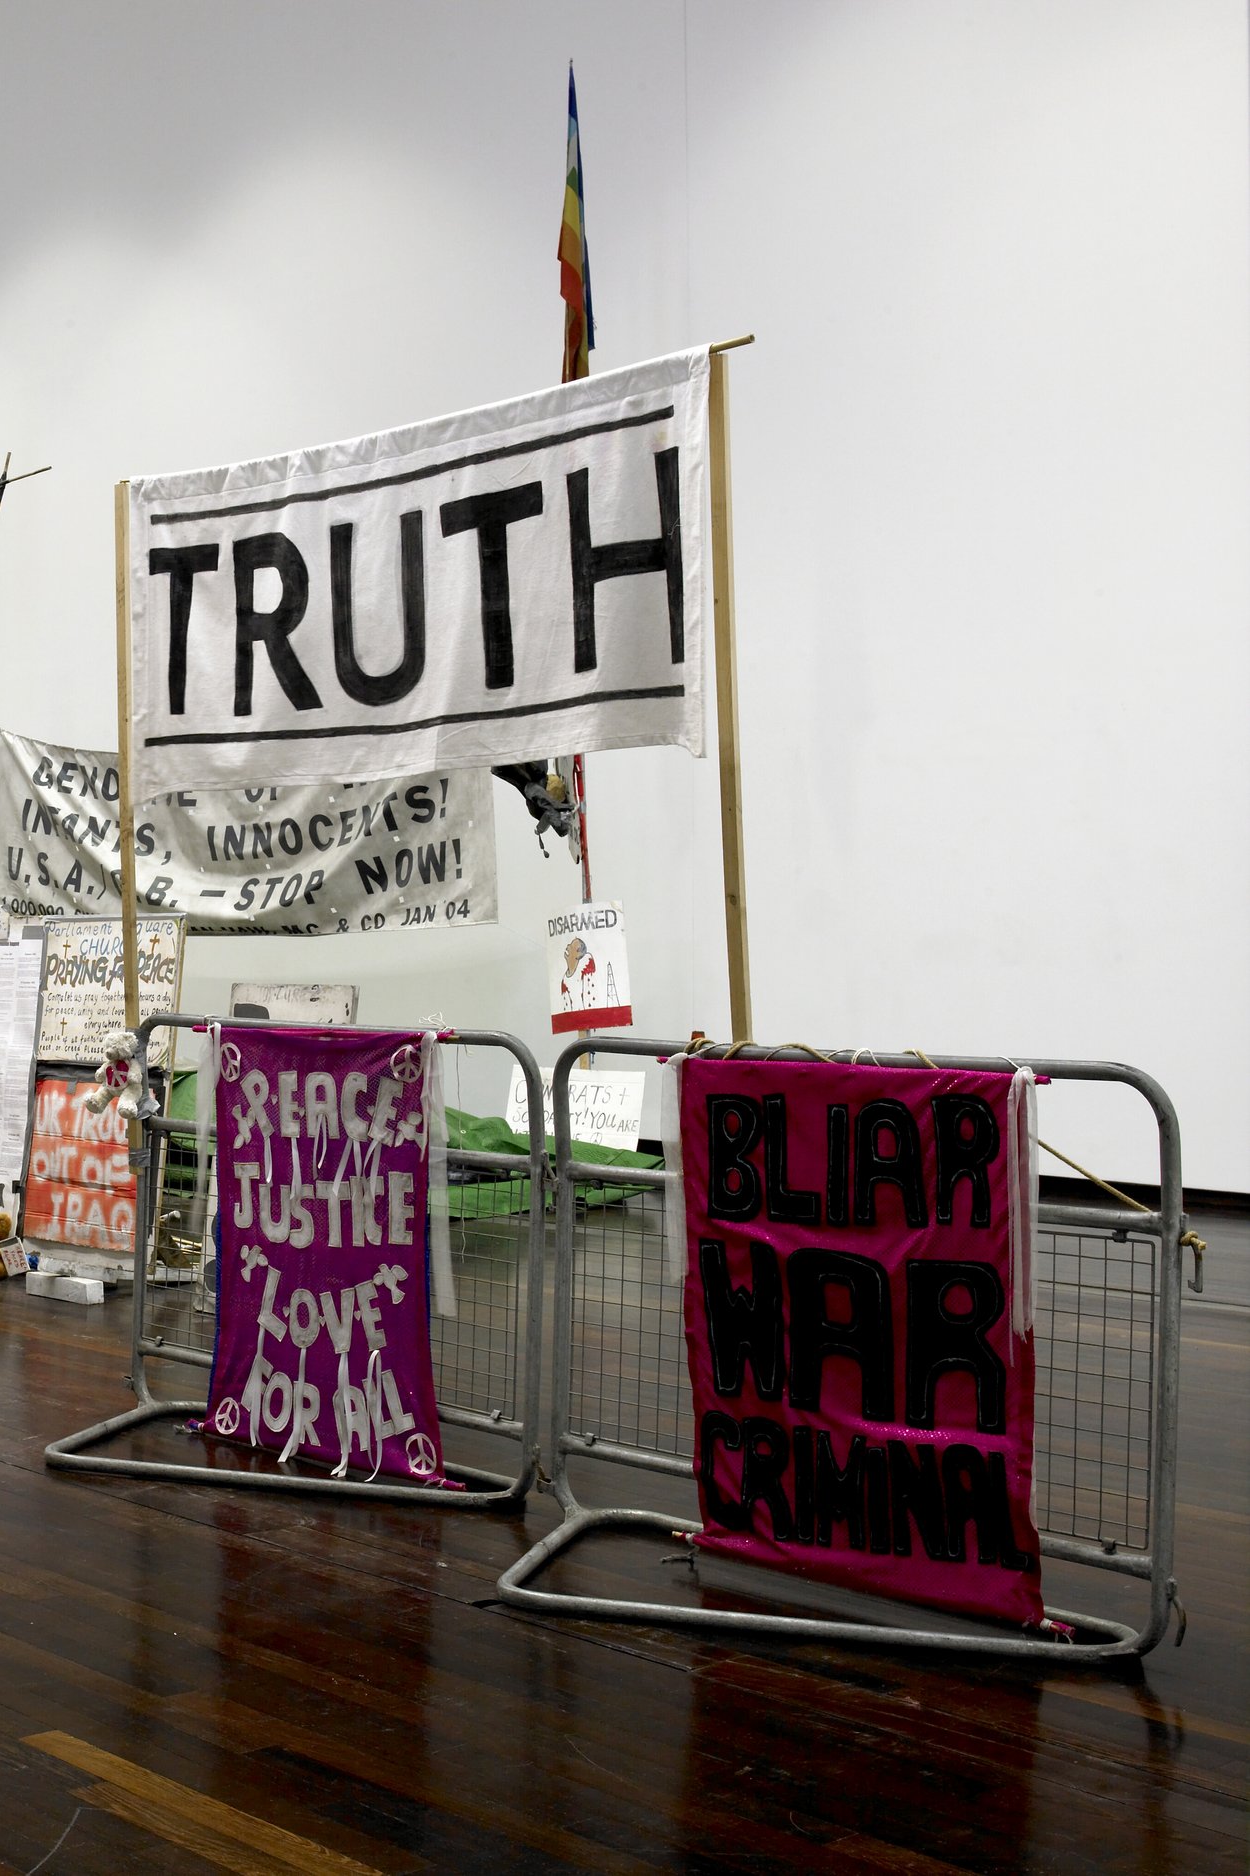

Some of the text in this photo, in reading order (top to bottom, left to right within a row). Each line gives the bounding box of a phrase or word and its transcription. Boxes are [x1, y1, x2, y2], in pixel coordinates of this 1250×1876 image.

[149, 446, 685, 717] TRUTH
[207, 778, 449, 861] INNOCENTS!
[233, 838, 462, 911] STOP NOW!
[400, 904, 437, 927] JAN
[547, 909, 618, 938] DISARMED
[45, 953, 109, 991] PRAYING
[37, 1089, 65, 1135] UK
[240, 1067, 405, 1147] PEACE
[590, 1111, 616, 1130] YOU
[33, 1146, 130, 1195] OUT OF
[706, 1092, 1000, 1229] BLIAR
[48, 1191, 134, 1250] IRAQ
[233, 1161, 415, 1250] JUSTICE
[257, 1264, 388, 1355] LOVE
[698, 1237, 1008, 1436] WAR
[240, 1355, 416, 1453] FOR ALL
[700, 1410, 1036, 1574] CRIMINAL
